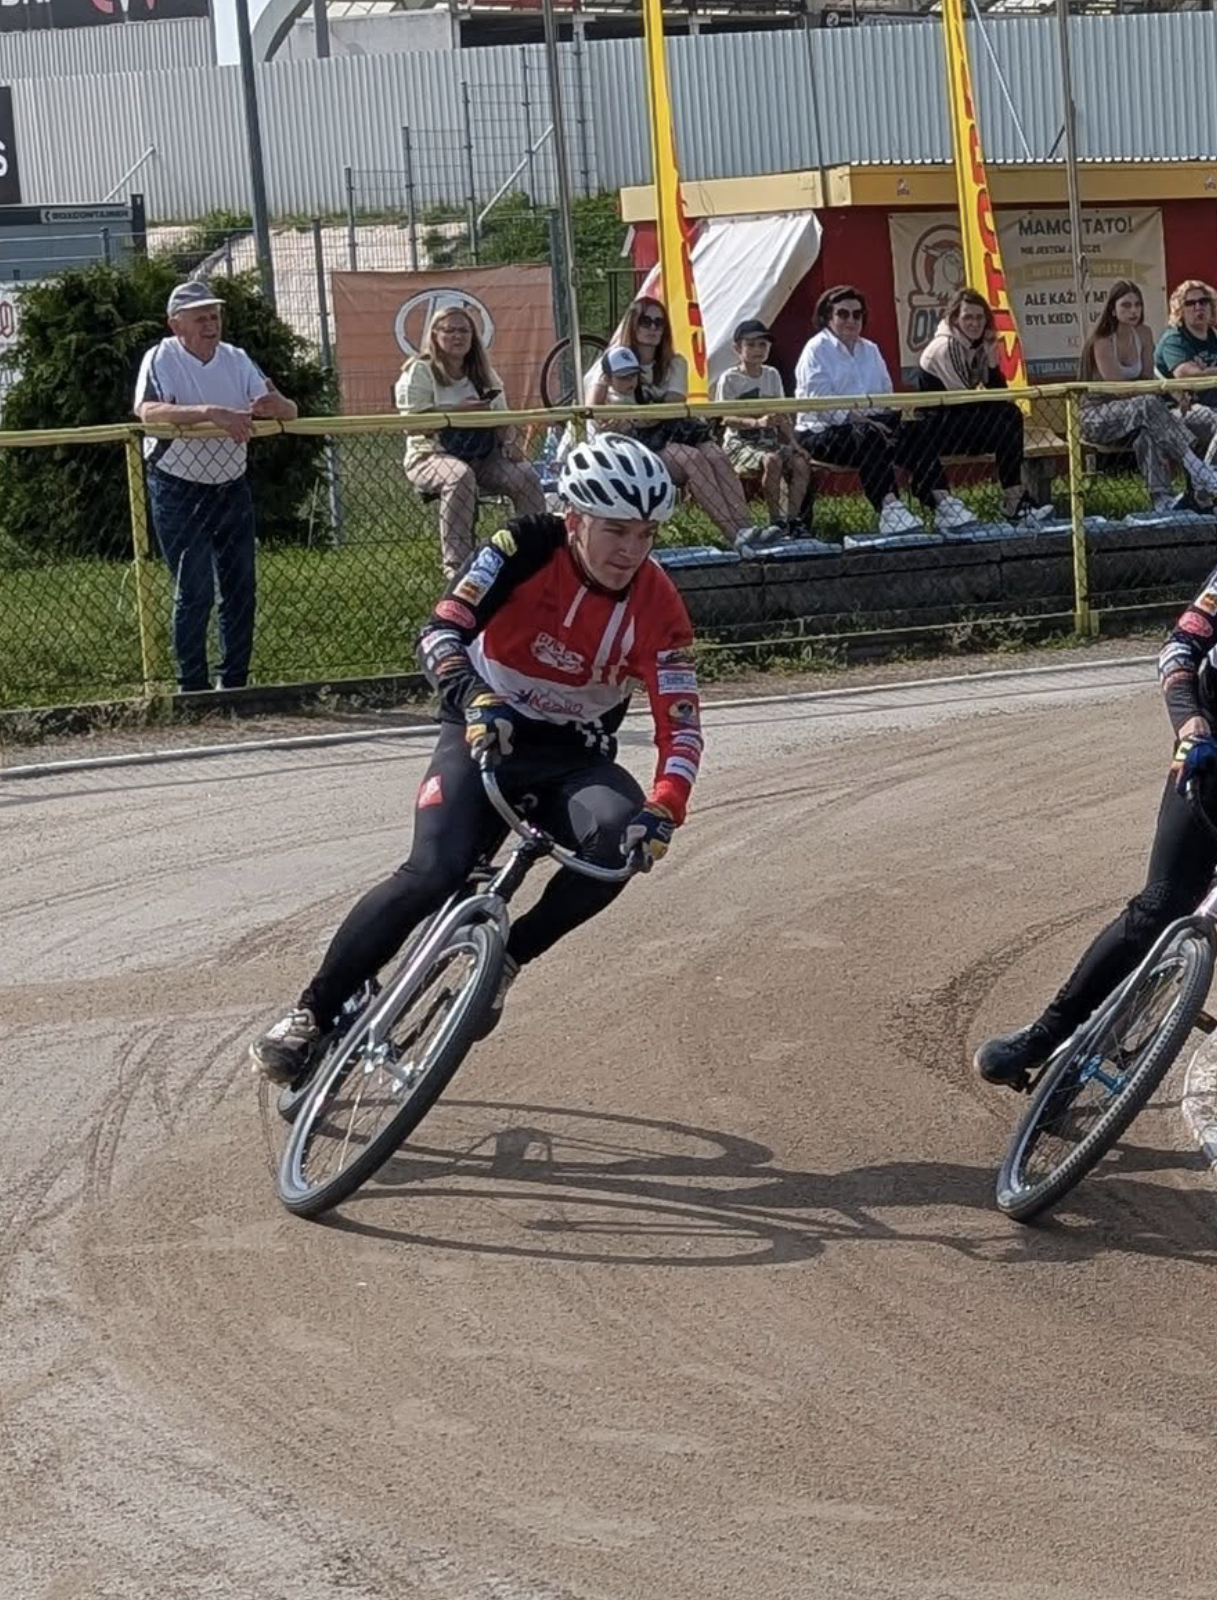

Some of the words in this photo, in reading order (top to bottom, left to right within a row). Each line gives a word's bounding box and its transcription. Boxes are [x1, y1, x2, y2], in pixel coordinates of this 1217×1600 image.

[1082, 216, 1134, 234] TATO!
[1024, 293, 1047, 306] ALE
[1050, 289, 1090, 304] KAŻY
